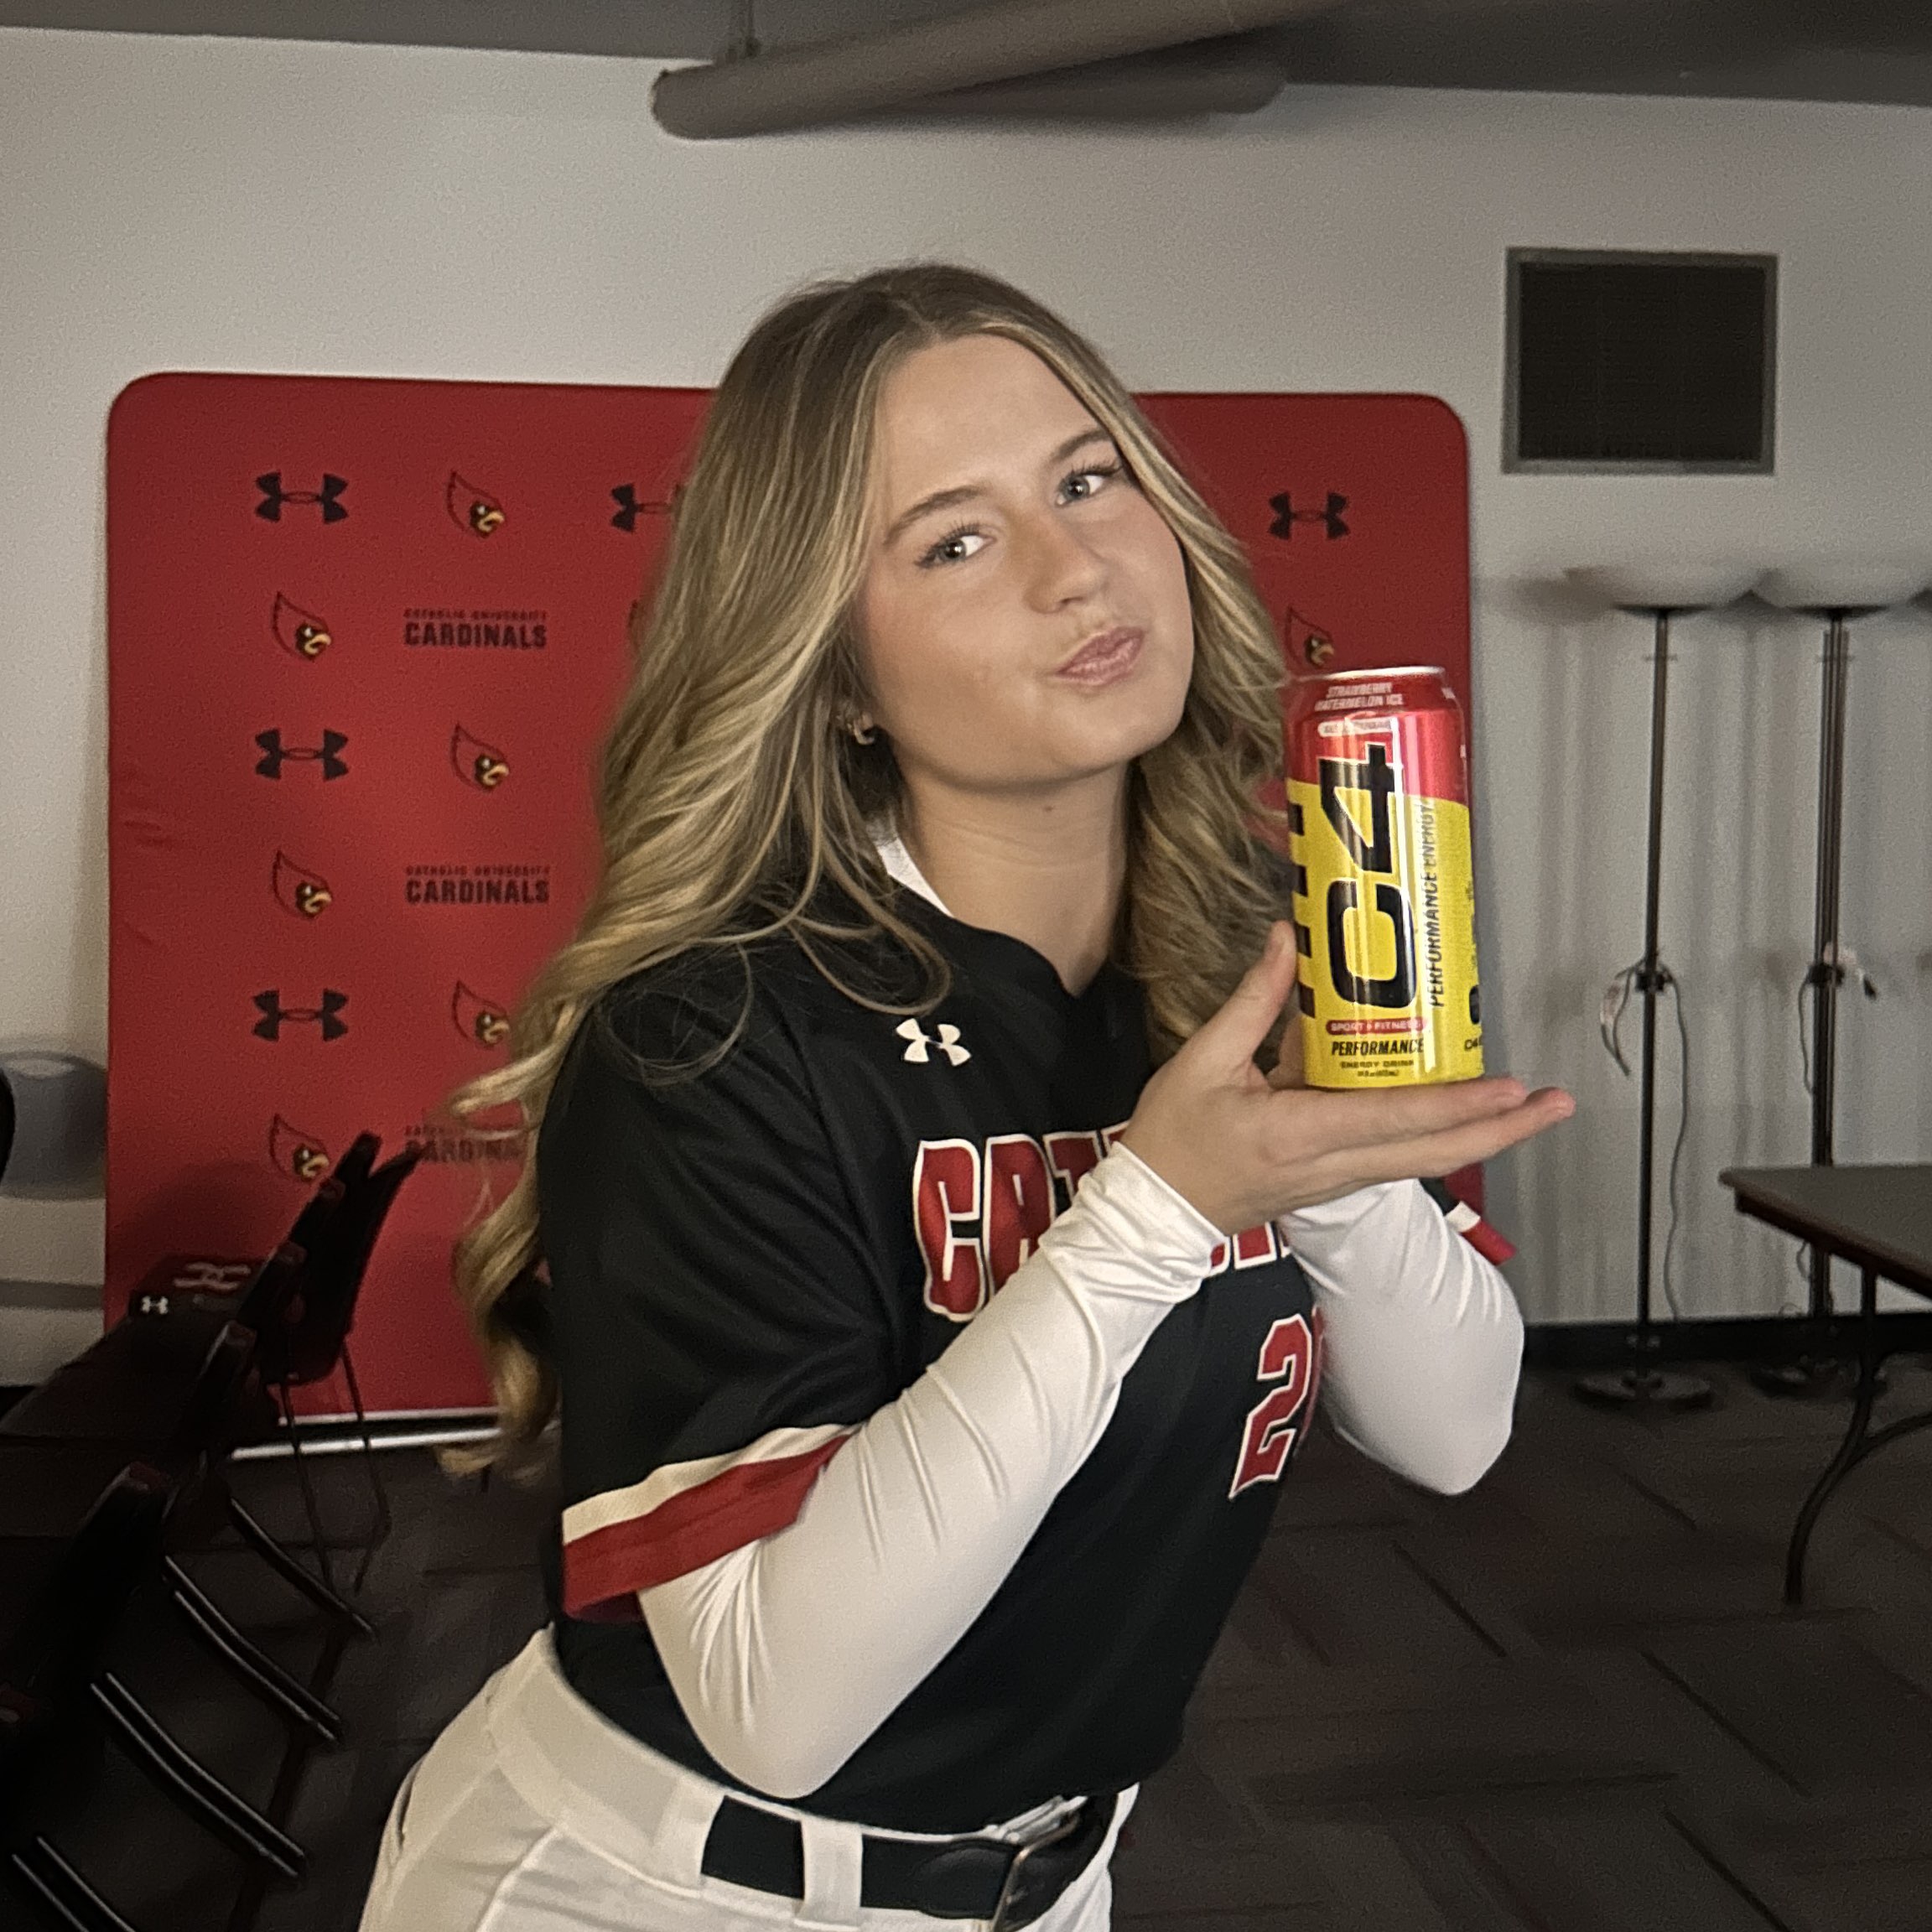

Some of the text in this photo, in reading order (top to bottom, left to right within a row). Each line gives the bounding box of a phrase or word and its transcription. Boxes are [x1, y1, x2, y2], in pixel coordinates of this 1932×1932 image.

[405, 622, 547, 649] CARDINALS
[1327, 683, 1392, 698] STRAWBERRY
[1314, 693, 1404, 711] WATERMELON ICE
[1317, 743, 1417, 1009] C4
[406, 880, 549, 903] CARDINALS
[1421, 871, 1444, 1007] PERFORMANCE
[1331, 1023, 1363, 1031] SPORT
[1331, 1038, 1424, 1056] PERFORMANCE
